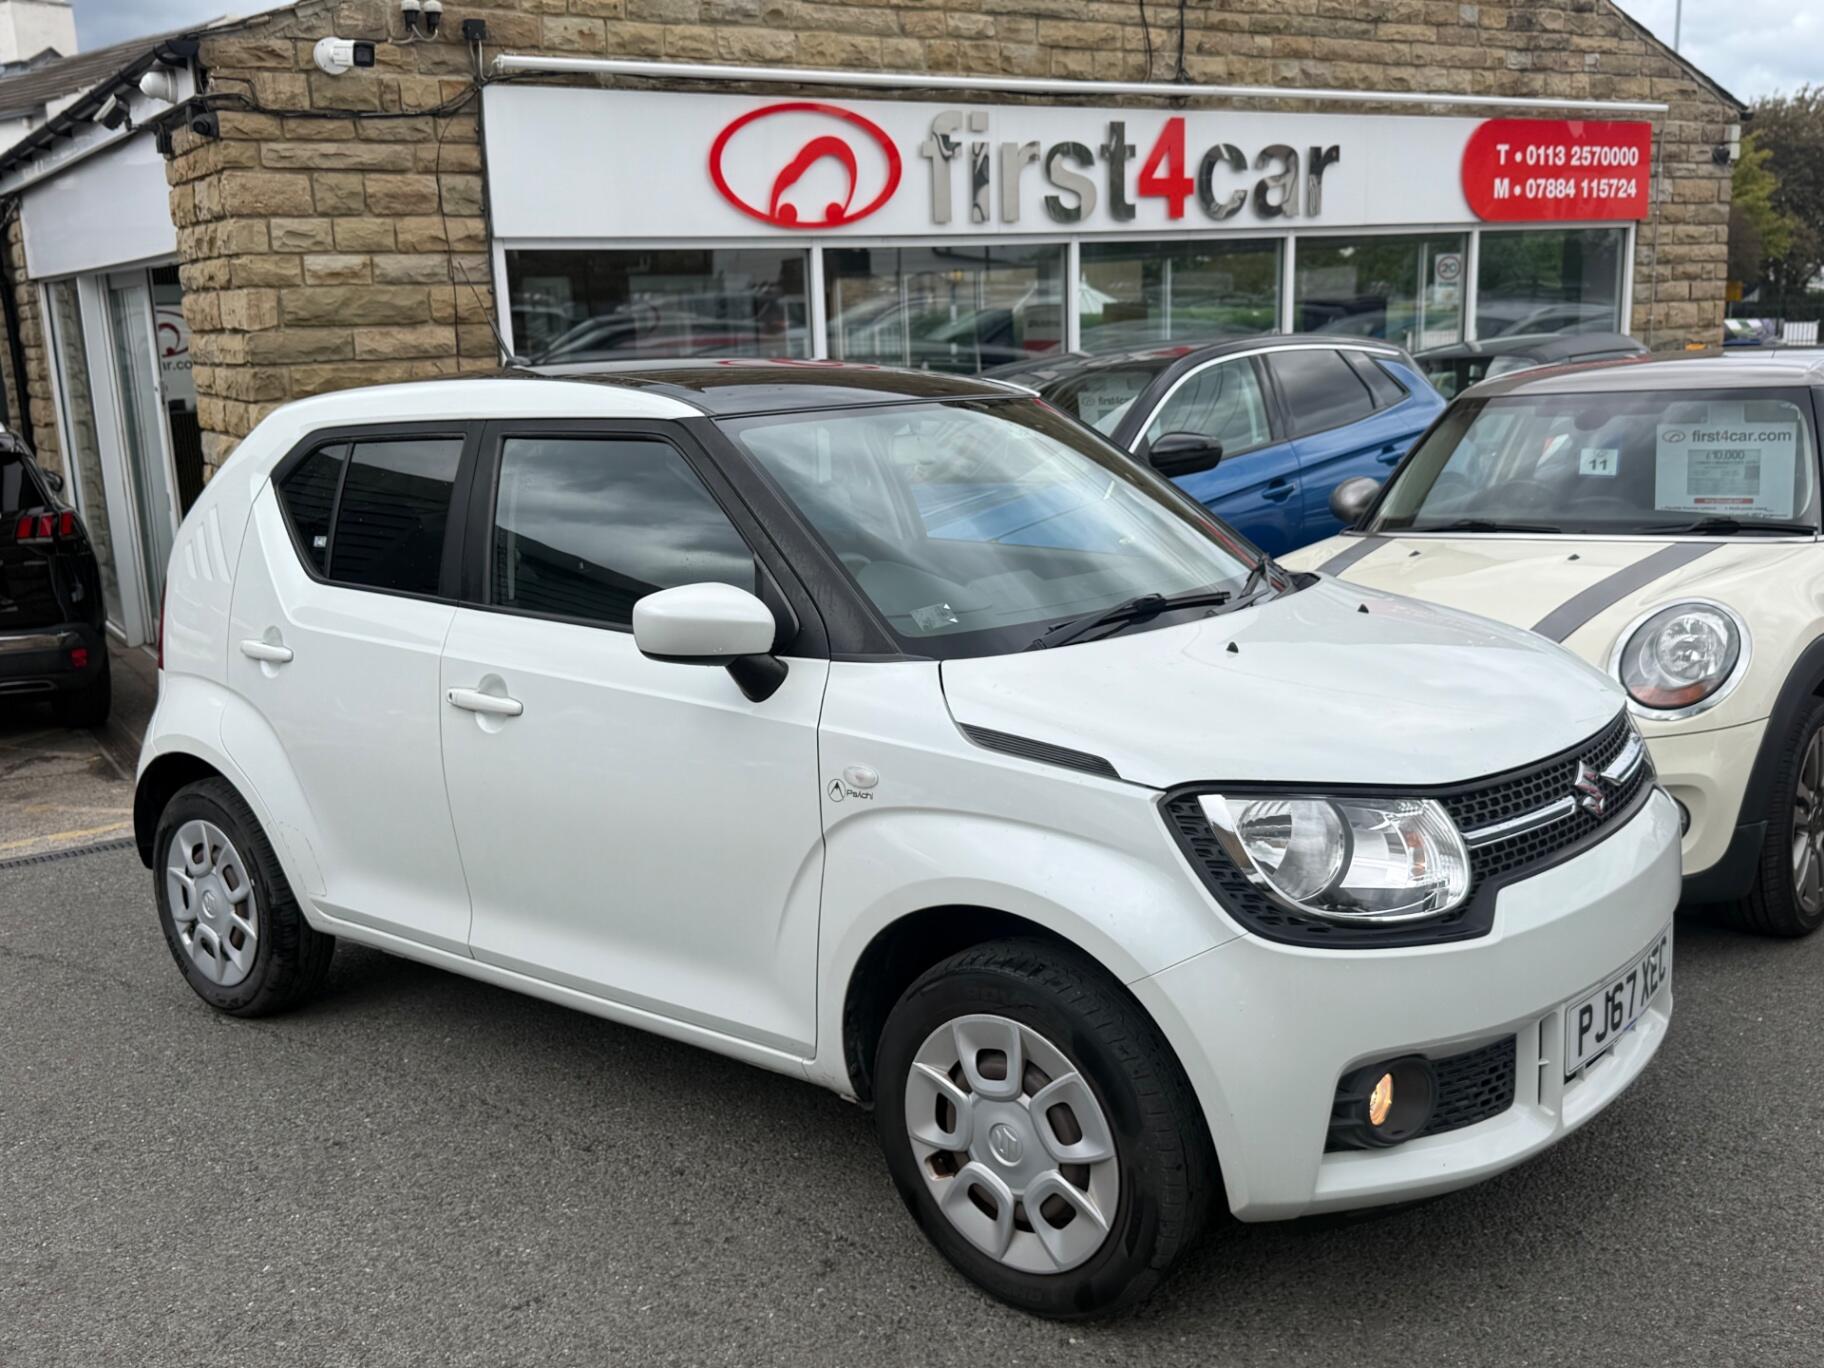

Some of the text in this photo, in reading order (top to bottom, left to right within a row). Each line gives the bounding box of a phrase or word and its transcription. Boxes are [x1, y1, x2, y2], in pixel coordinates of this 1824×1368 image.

[1496, 144, 1639, 166] T 0113 2570000
[921, 109, 1341, 226] first4car
[1493, 177, 1637, 199] M 07884 115724
[1692, 430, 1792, 443] first4car.com
[1589, 459, 1607, 470] 11
[1578, 935, 1667, 1057] PJ67 XEC
